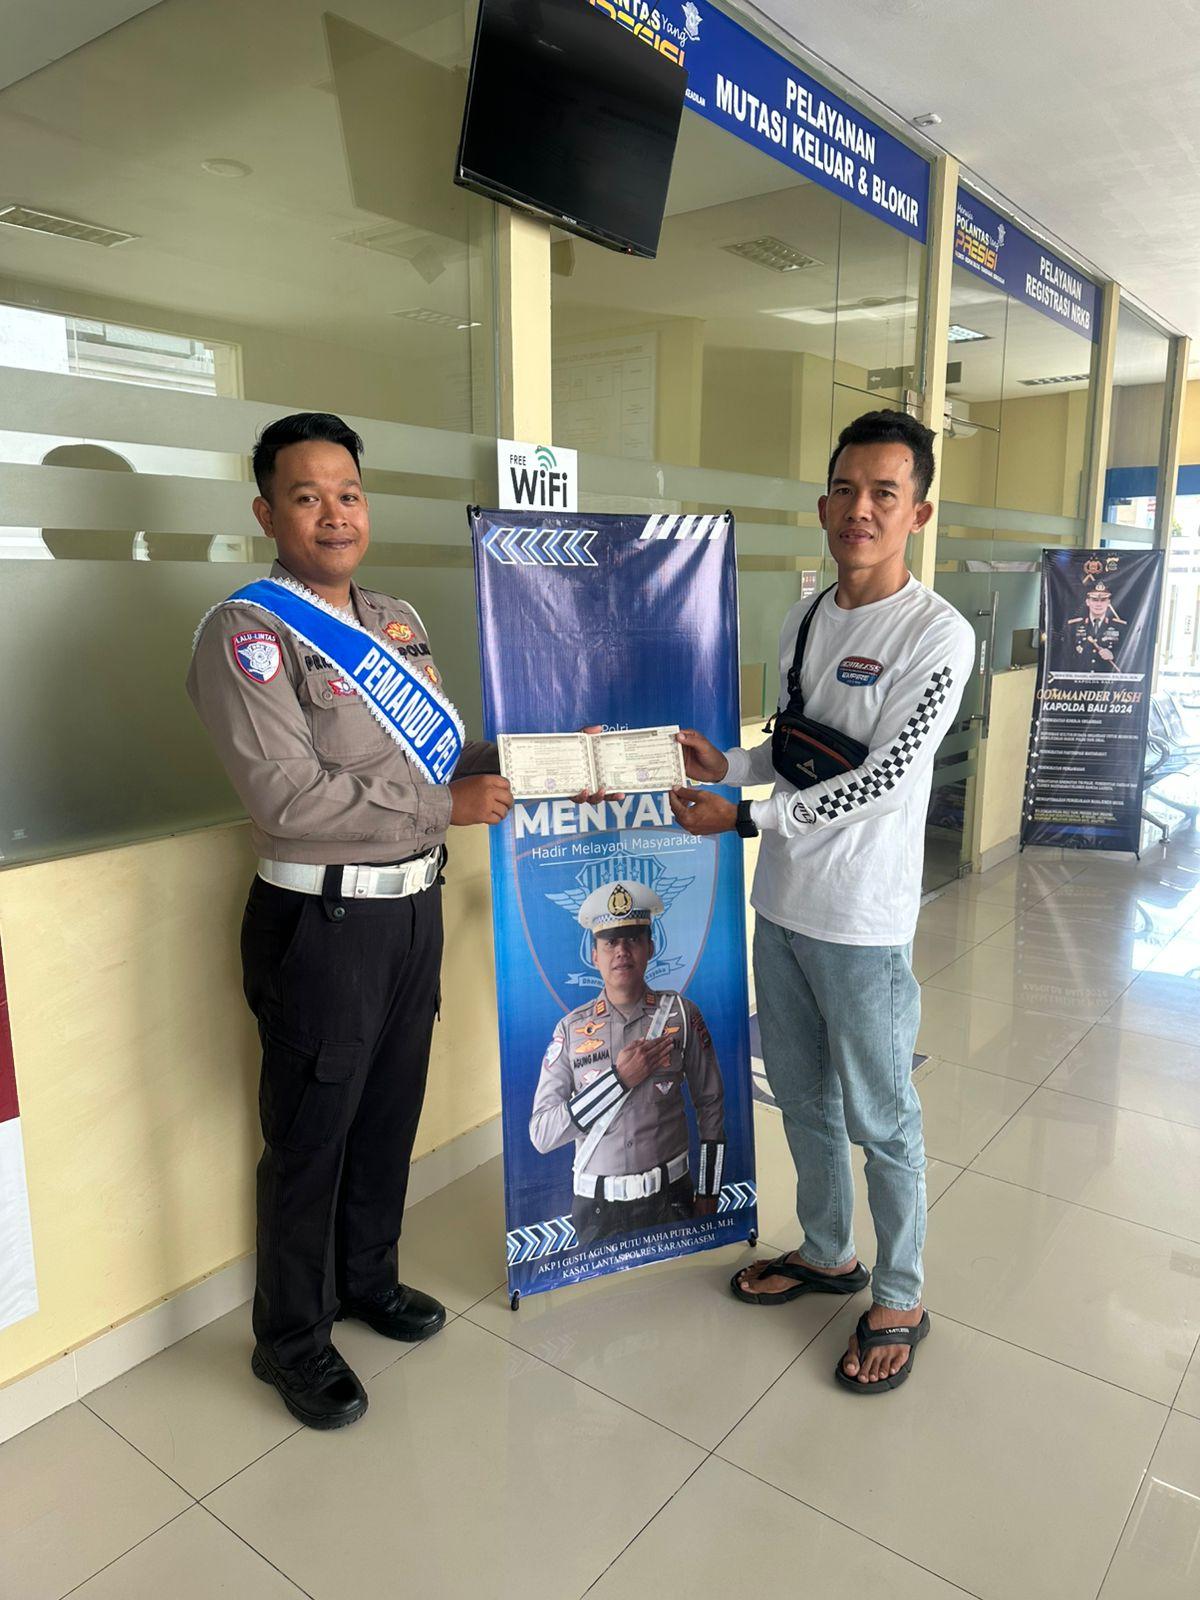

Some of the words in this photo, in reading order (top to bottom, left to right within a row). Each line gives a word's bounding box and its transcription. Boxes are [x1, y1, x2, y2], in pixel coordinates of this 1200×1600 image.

[786, 77, 875, 165] PELAYANAN
[716, 73, 787, 148] MUTASI
[792, 122, 854, 188] KELUAR
[857, 166, 868, 196] &
[872, 174, 918, 227] BLOKIR
[955, 229, 998, 271] PRESISI
[956, 213, 990, 246] POLANTAS
[1040, 256, 1082, 301] PELAYANAN
[1026, 273, 1071, 318] REGISTRASI
[1071, 302, 1090, 330] NRKB
[510, 454, 526, 466] FREE
[510, 467, 568, 508] WiFi
[235, 634, 252, 644] LALU
[254, 633, 276, 642] LINTAS
[353, 646, 444, 748] PEMANDU
[1037, 688, 1111, 702] COMMANDER
[1111, 689, 1142, 704] WISH
[1043, 702, 1085, 712] KAPOLDA
[1087, 703, 1107, 713] BALI
[1109, 704, 1132, 714] 2024
[601, 723, 629, 735] Polri
[532, 846, 567, 859] Hadir
[572, 840, 627, 856] Melayani
[632, 833, 702, 850] Masyarakat
[593, 1050, 609, 1063] MAHA
[538, 1261, 556, 1273] AKP
[562, 1252, 587, 1267] GUSTI
[588, 1244, 618, 1259] AGUNG
[620, 1238, 641, 1250] PUTU
[643, 1231, 669, 1244] MAHA
[562, 1263, 590, 1279] KASAT
[657, 1233, 715, 1253] KARANGASEM
